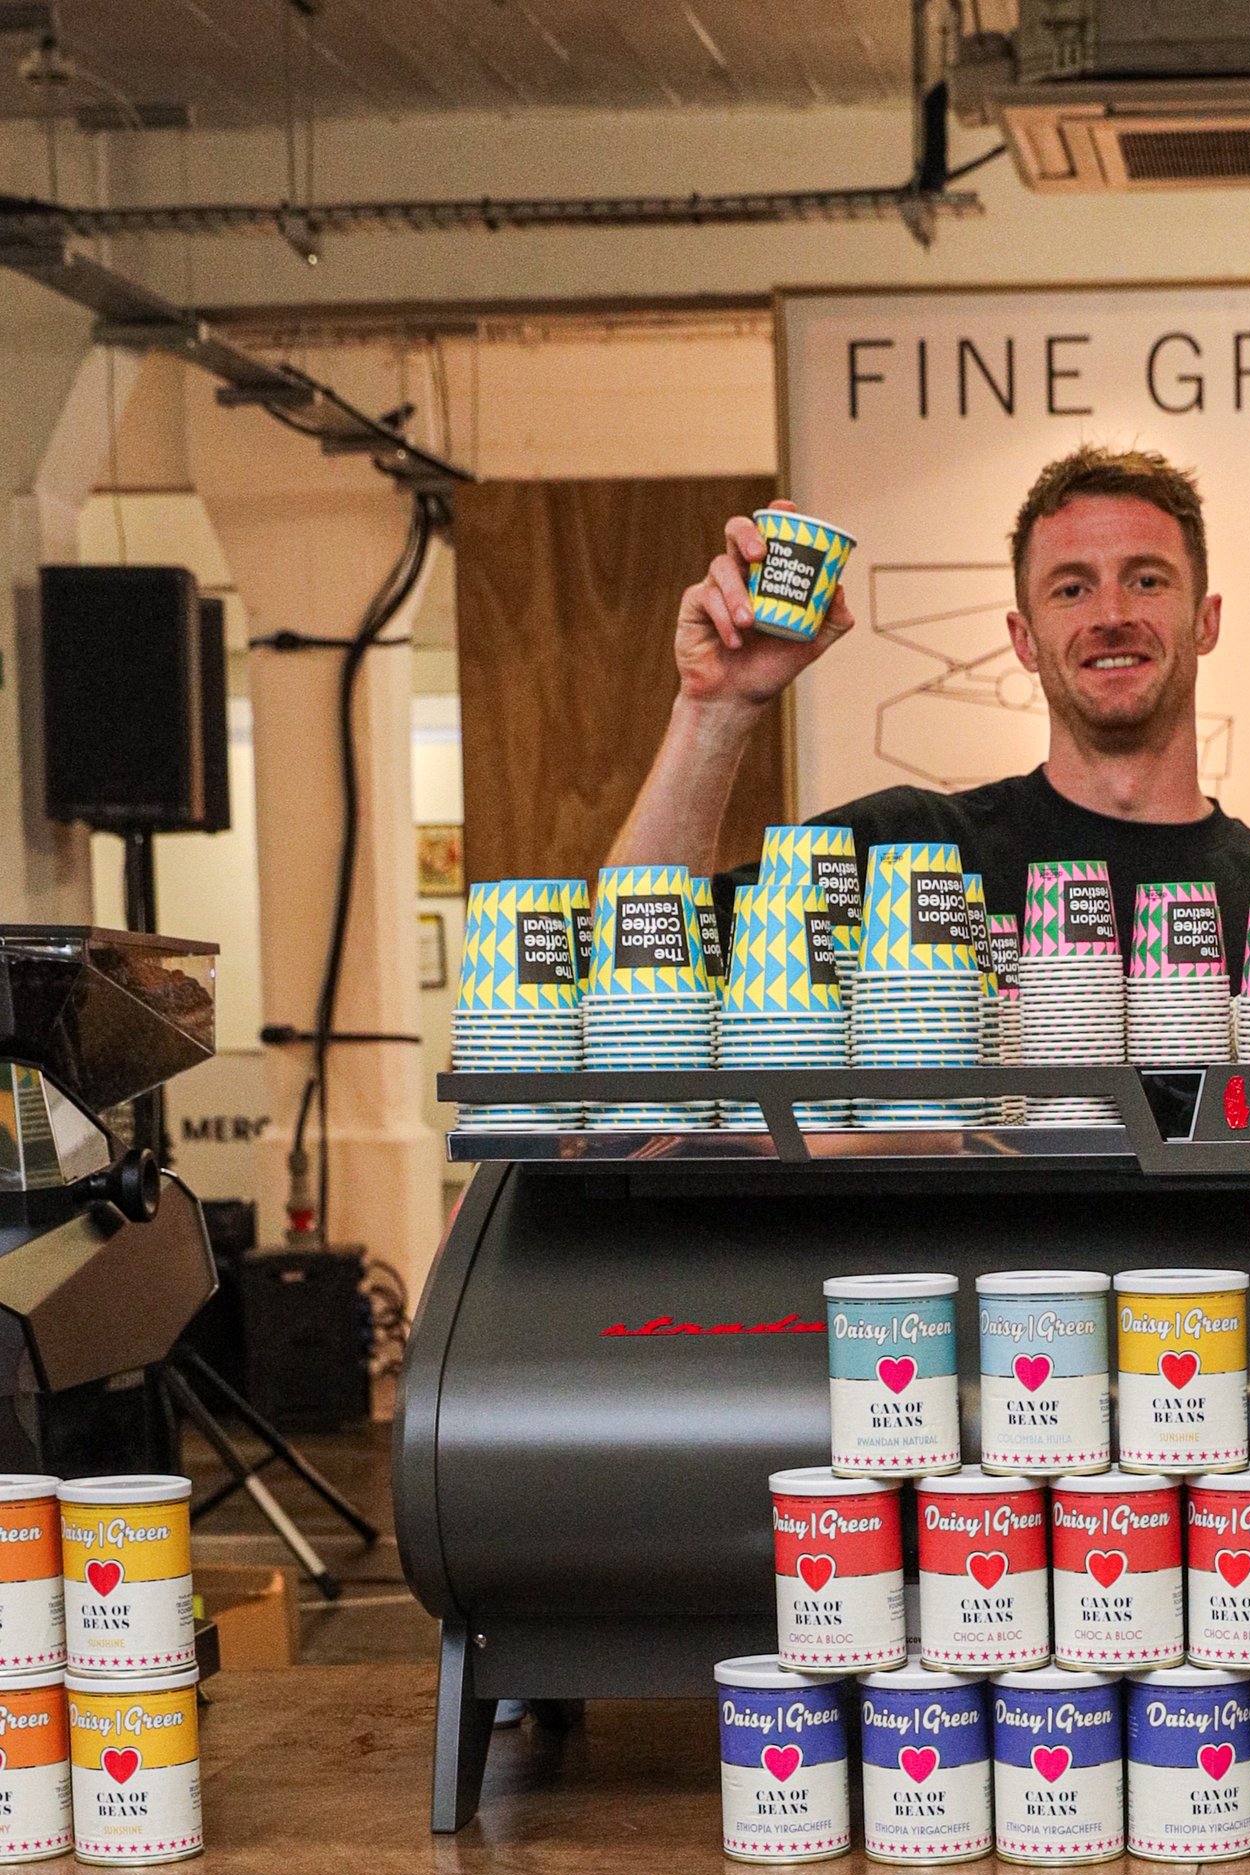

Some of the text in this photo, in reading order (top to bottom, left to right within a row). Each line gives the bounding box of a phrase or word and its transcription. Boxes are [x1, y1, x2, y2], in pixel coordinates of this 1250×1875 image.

[847, 333, 1094, 420] FINE
[769, 542, 792, 557] The
[766, 555, 815, 576] London
[764, 567, 810, 589] Coffee
[761, 580, 808, 602] Festival
[622, 901, 677, 916] Festival
[1174, 908, 1215, 919] Festival
[622, 918, 680, 931] Coffee
[1174, 921, 1217, 932] Coffee
[622, 934, 682, 949] London
[1174, 935, 1218, 946] London
[655, 948, 684, 961] The
[1201, 947, 1219, 958] The
[871, 1402, 924, 1414] CAN OF
[1007, 1400, 1059, 1412] CAN OF
[1153, 1398, 1206, 1409] CAN OF
[873, 1417, 922, 1427] BEANS
[1009, 1414, 1057, 1425] BEANS
[1155, 1412, 1204, 1422] BEANS
[857, 1435, 938, 1447] RWANDAN NATURAL
[1159, 1433, 1200, 1442] SUNSHINE
[794, 1601, 843, 1612] CAN OF
[961, 1597, 1015, 1609] CAN OF
[1081, 1597, 1134, 1607] CAN OF
[1210, 1597, 1236, 1607] CAN
[82, 1605, 131, 1616] CAN OF
[1083, 1611, 1132, 1621] BEANS
[796, 1614, 841, 1625] BEANS
[963, 1612, 1013, 1623] BEANS
[84, 1618, 129, 1629] BEANS
[953, 1632, 984, 1642] CHOC
[997, 1630, 1022, 1641] BLOC
[97, 1792, 149, 1803] CAN OF
[756, 1789, 810, 1801] CAN OF
[894, 1791, 947, 1802] CAN OF
[1026, 1790, 1079, 1802] CAN OF
[1191, 1786, 1240, 1801] CAN OF
[99, 1806, 147, 1816] BEANS
[759, 1804, 807, 1814] BEANS
[896, 1806, 945, 1816] BEANS
[1028, 1805, 1076, 1815] BEANS
[1193, 1802, 1238, 1814] BEANS
[736, 1819, 832, 1834] ETHIOPIA YIRGACHEFFE
